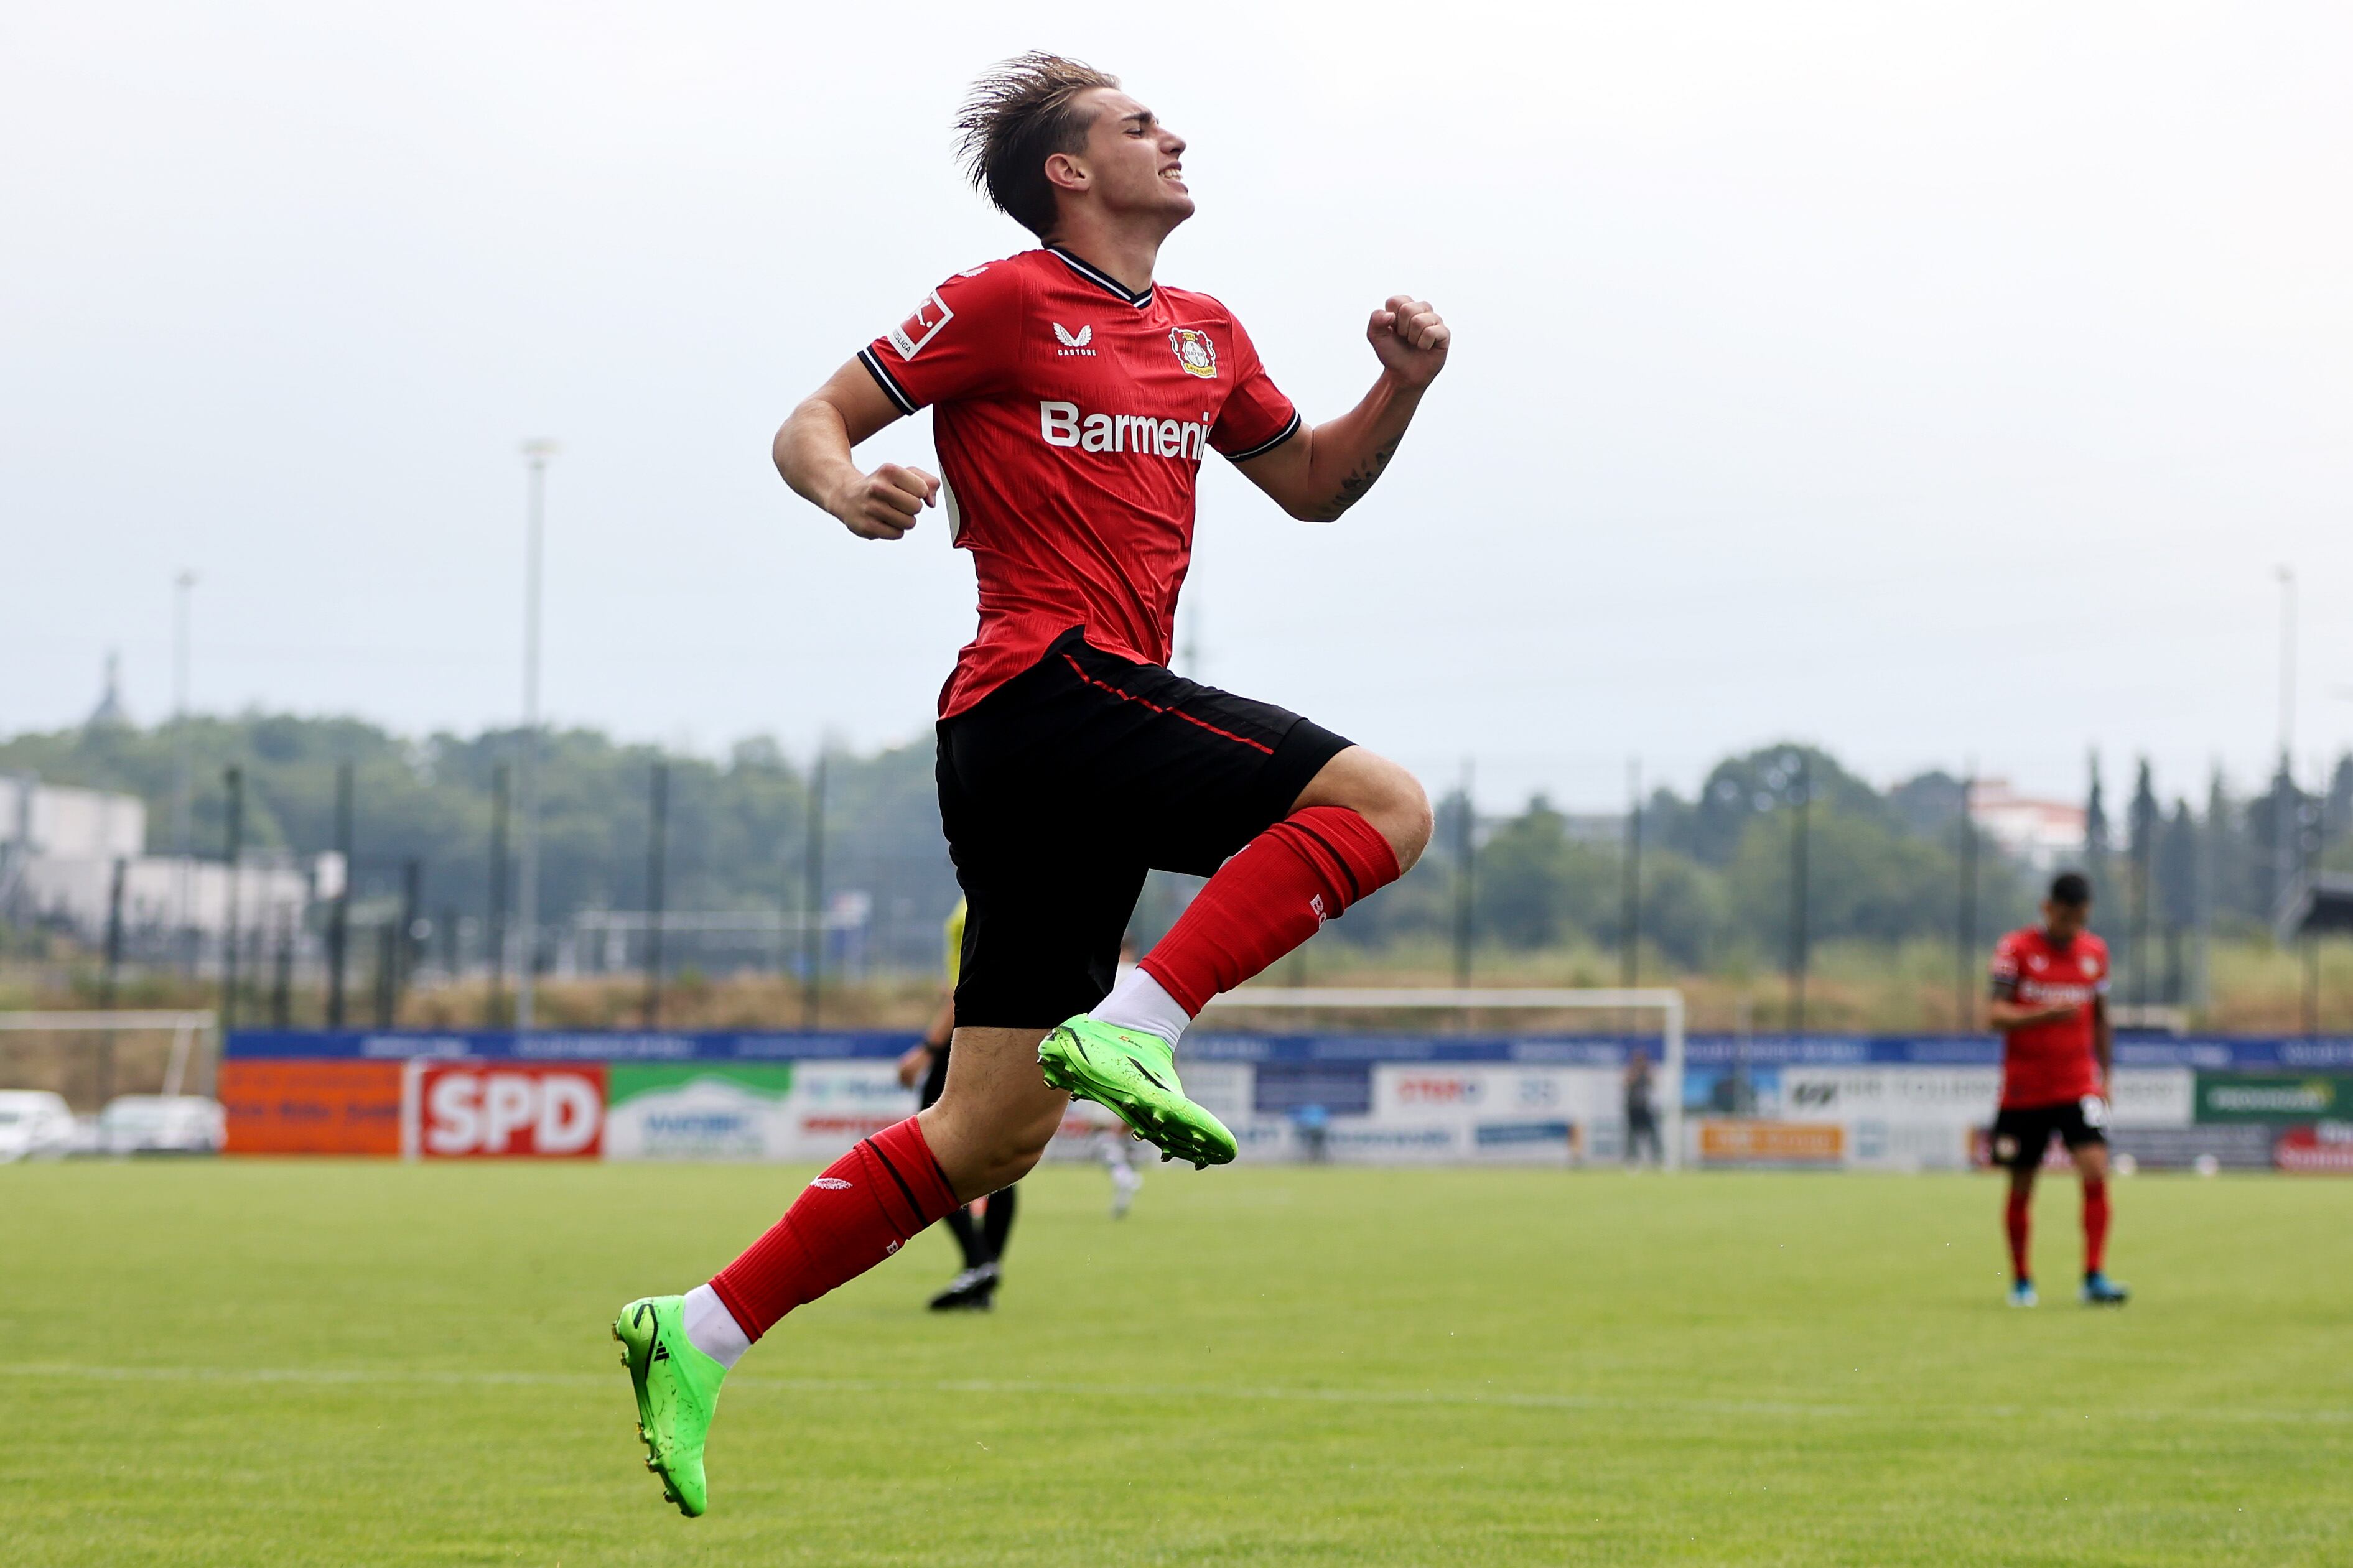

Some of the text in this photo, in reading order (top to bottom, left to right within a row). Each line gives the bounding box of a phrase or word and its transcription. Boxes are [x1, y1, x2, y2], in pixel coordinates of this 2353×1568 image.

[892, 327, 911, 353] ESLIGA
[1040, 401, 1213, 460] Barmeni
[429, 1071, 602, 1151] SPD
